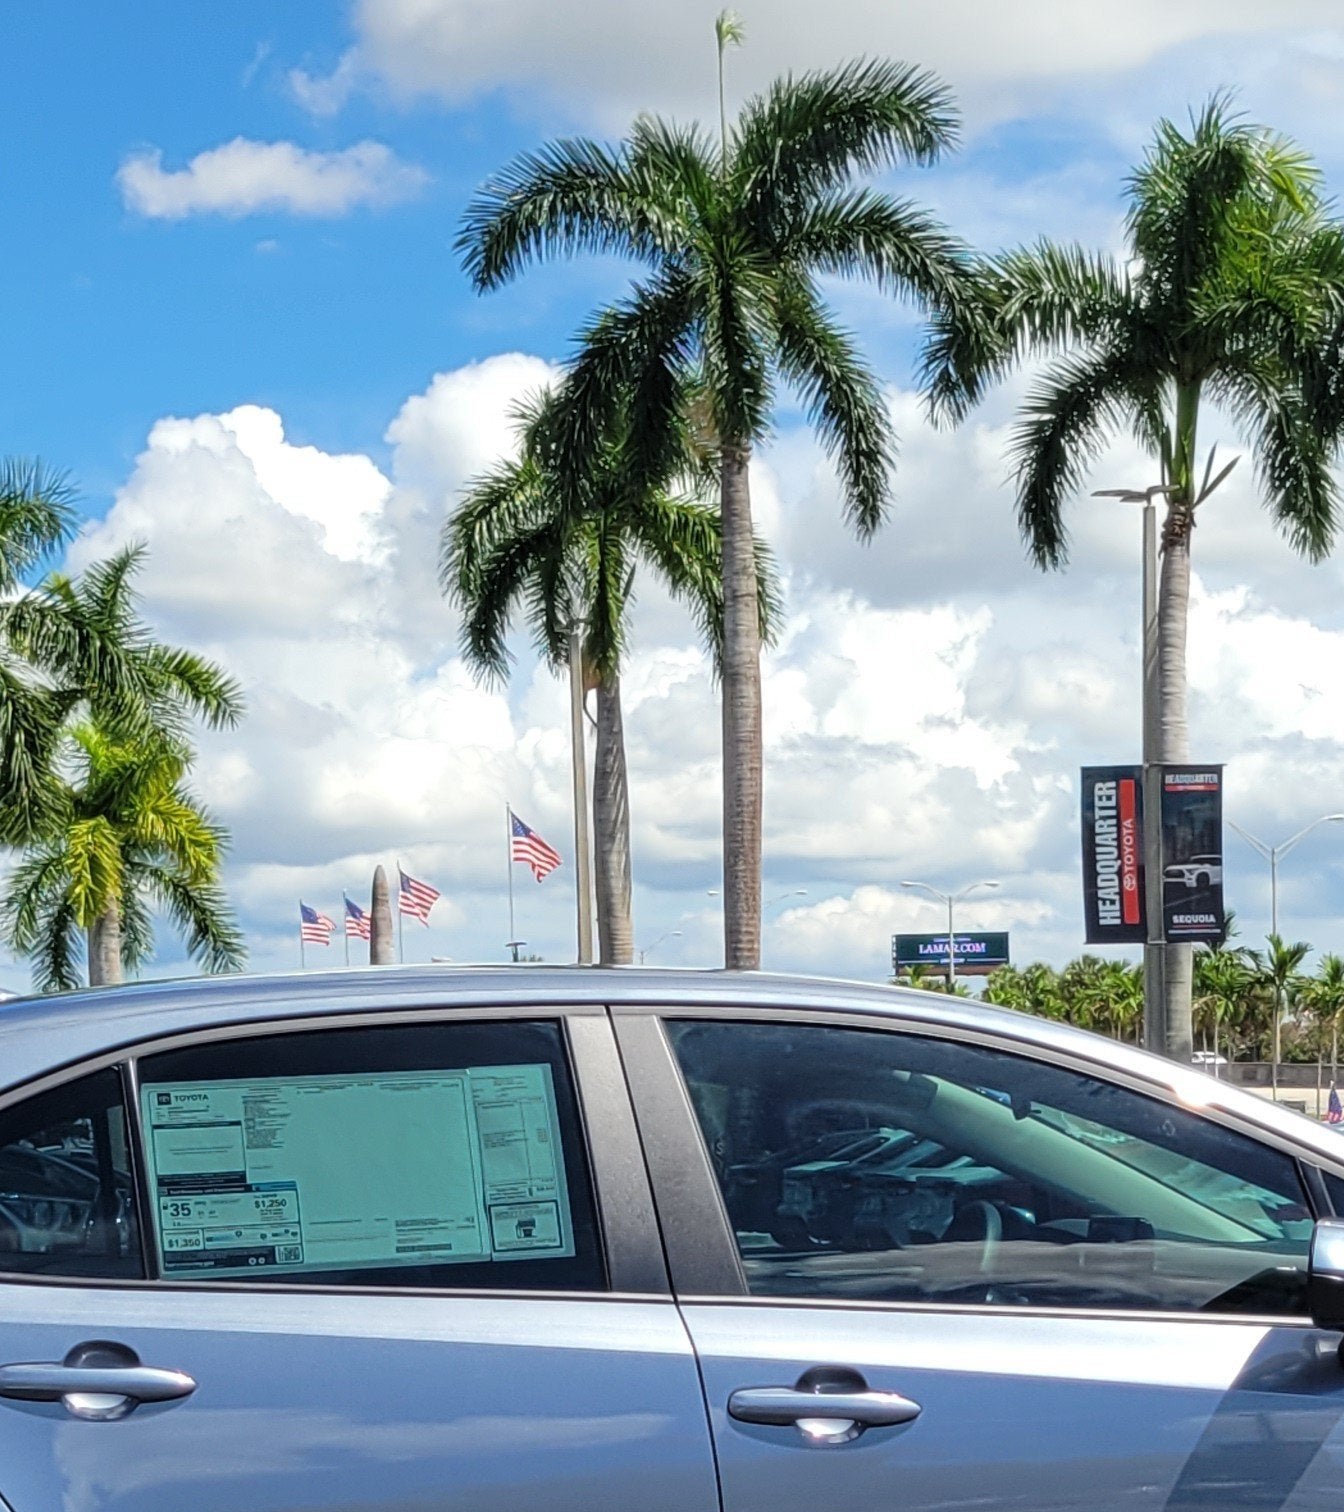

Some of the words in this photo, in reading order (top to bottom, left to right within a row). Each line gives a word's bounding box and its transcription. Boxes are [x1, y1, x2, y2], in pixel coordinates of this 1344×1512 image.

[1095, 781, 1121, 926] HEADQUARTER
[1122, 818, 1135, 874] TOYOTA
[1172, 914, 1216, 924] SEQUOIA
[173, 1094, 209, 1102] TOYOTA
[169, 1202, 192, 1217] 35
